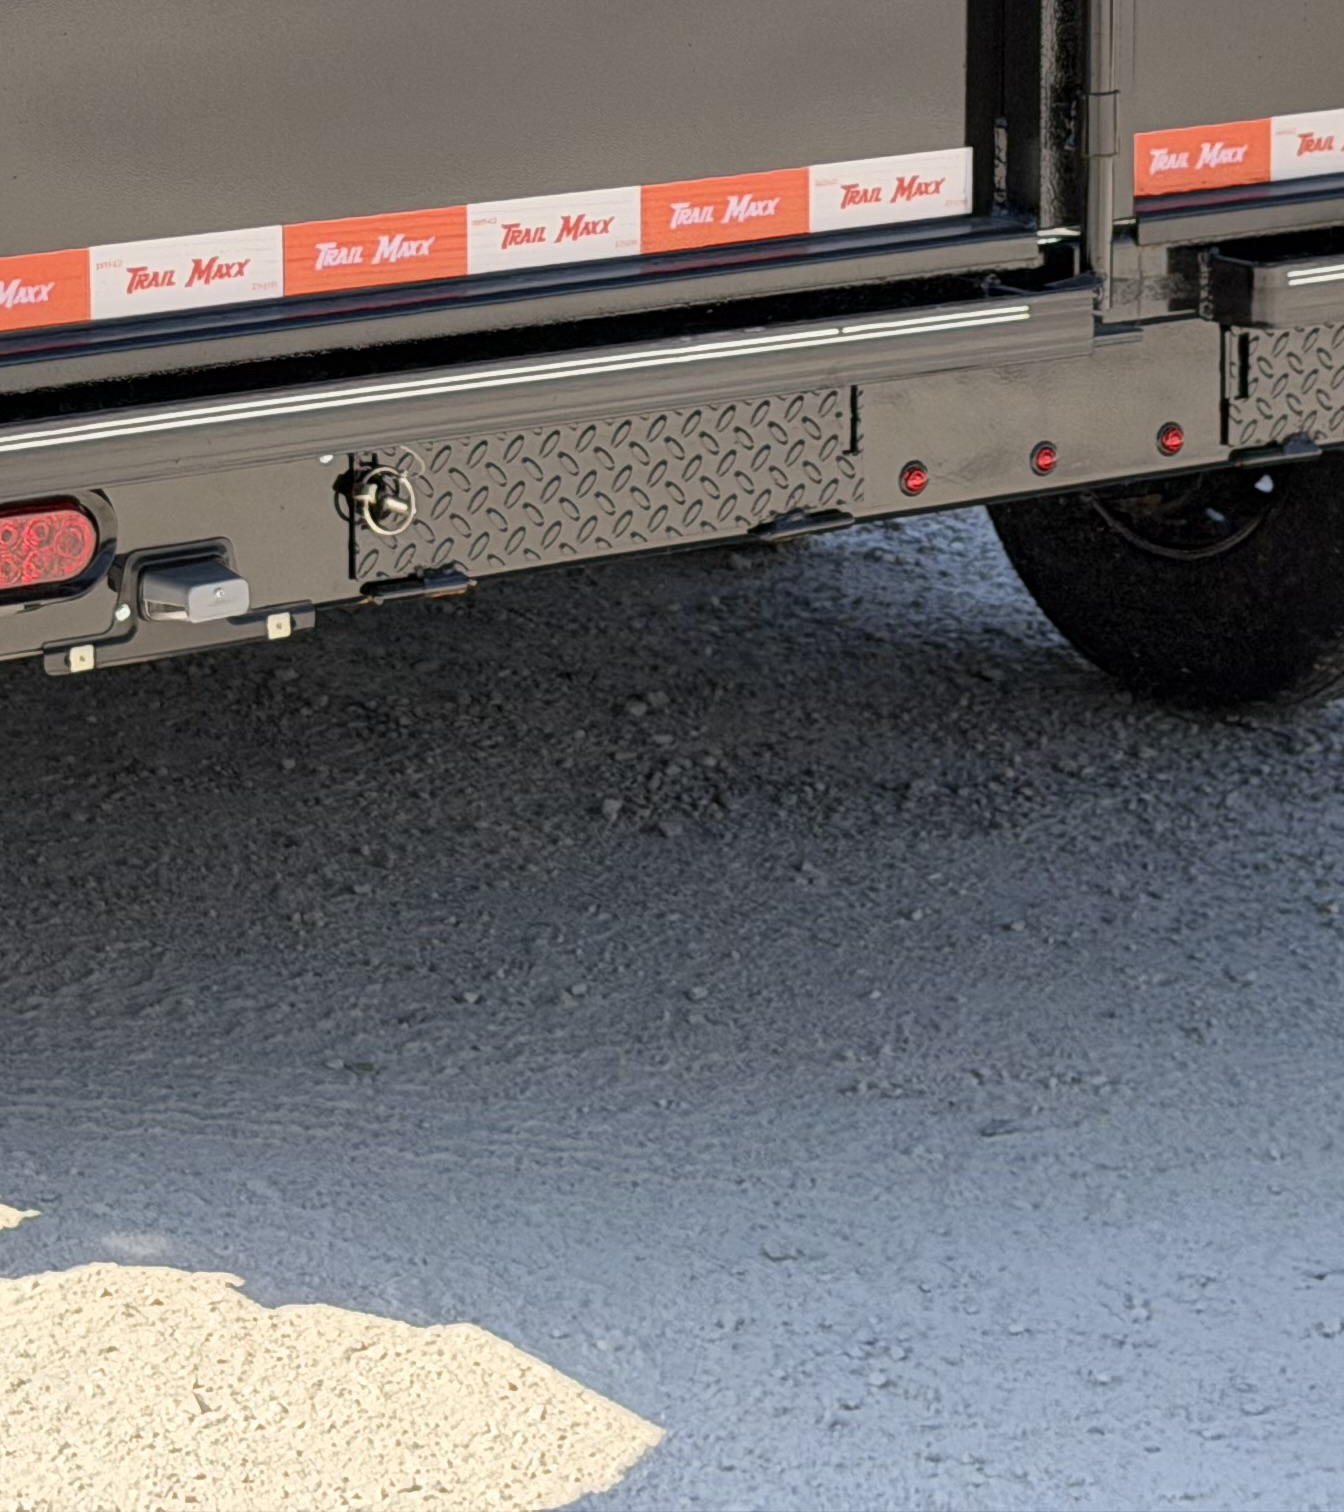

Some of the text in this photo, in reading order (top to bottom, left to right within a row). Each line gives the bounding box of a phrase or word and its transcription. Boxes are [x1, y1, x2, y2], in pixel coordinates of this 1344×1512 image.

[1150, 142, 1248, 174] TRAIL MAXX
[841, 176, 945, 209] TRAIL MAXX
[670, 194, 779, 229] TRAIL MAXX
[502, 214, 614, 249] TRAIL MAXX
[316, 234, 434, 270] TRAIL MAXX
[127, 256, 250, 294] TRAIL MAXX
